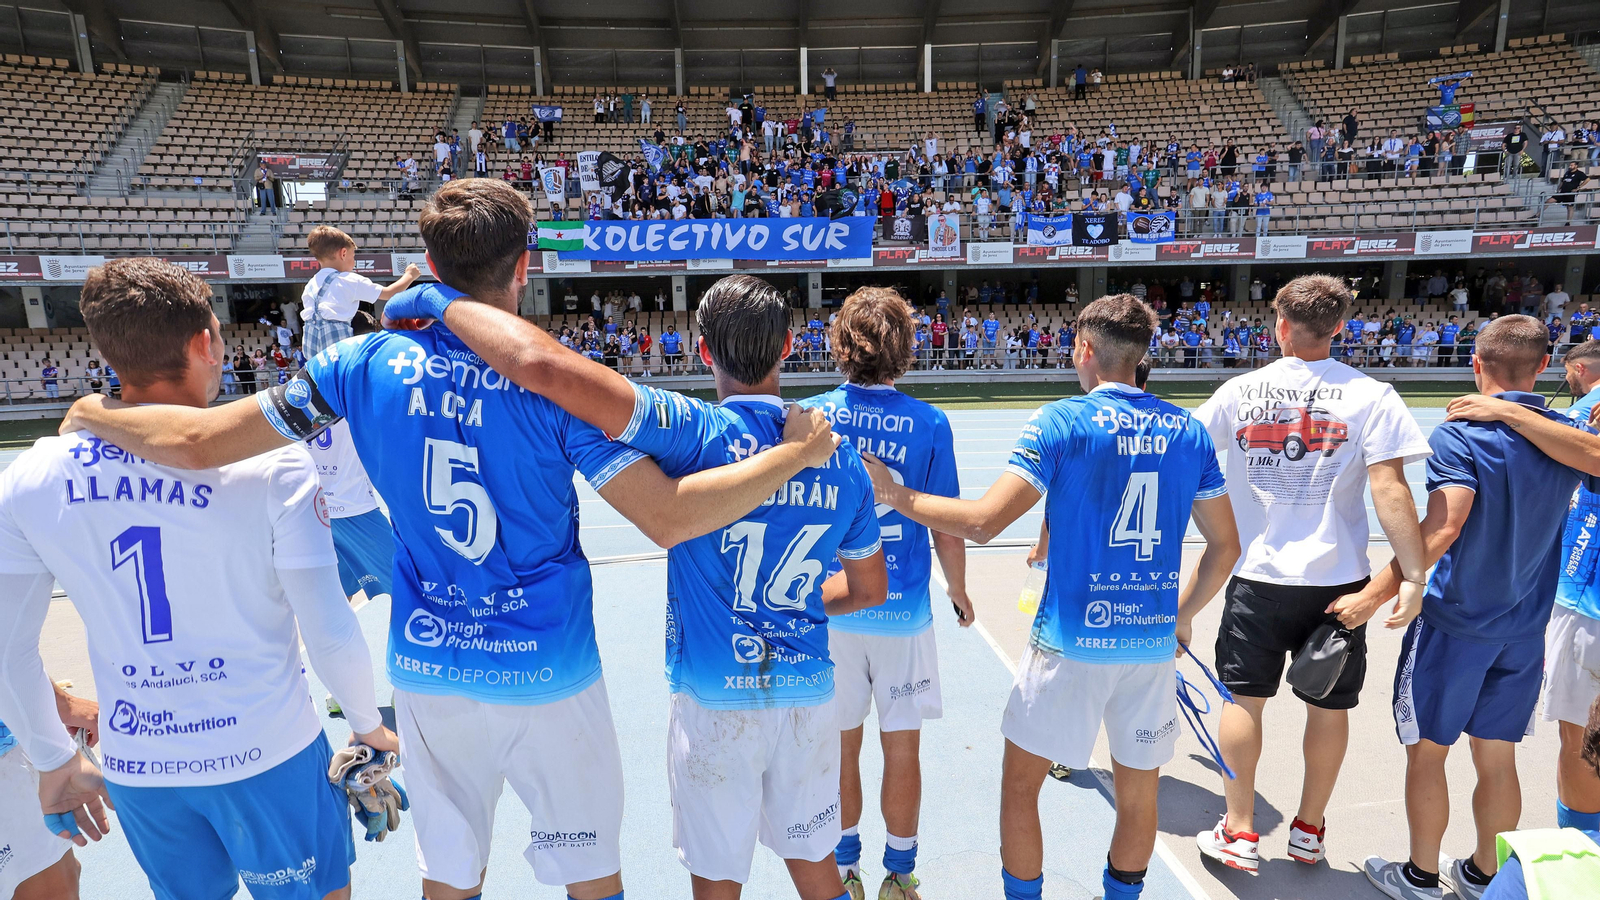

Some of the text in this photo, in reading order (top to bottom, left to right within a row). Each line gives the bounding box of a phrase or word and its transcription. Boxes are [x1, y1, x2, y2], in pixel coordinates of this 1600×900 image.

[583, 221, 850, 252] KOLECTIVO SUR
[1312, 241, 1352, 250] PLAY
[1479, 234, 1523, 246] PLAY
[878, 250, 912, 259] PLAY
[1018, 246, 1052, 256] PLAY
[1161, 244, 1197, 254] PLAY
[290, 260, 319, 270] PLA
[407, 387, 435, 417] A.
[853, 403, 885, 415] clínicas
[1237, 399, 1282, 422] Golf
[857, 435, 908, 465] PLAZA
[1116, 434, 1168, 456] HUGO
[1255, 455, 1274, 467] Mk
[65, 475, 214, 510] LLAMAS
[422, 436, 498, 567] 5
[1108, 471, 1162, 562] 4
[720, 520, 833, 614] 16
[110, 525, 173, 645] 1
[1089, 571, 1180, 583] VOLVO
[1089, 583, 1120, 593] Talleres
[1161, 582, 1178, 590] SCA
[501, 598, 529, 614] SCA
[1113, 602, 1139, 616] High
[447, 621, 484, 639] High
[1074, 636, 1118, 649] XEREZ
[121, 657, 226, 678] OLVO
[200, 670, 228, 683] SCA
[394, 652, 553, 686] XEREZ DEPORTIVO
[723, 664, 836, 690] XEREZ DEPORTIVO
[138, 709, 174, 727] High
[103, 747, 263, 776] XEREZ DEPORTIVO
[530, 830, 597, 842] PODATCON
